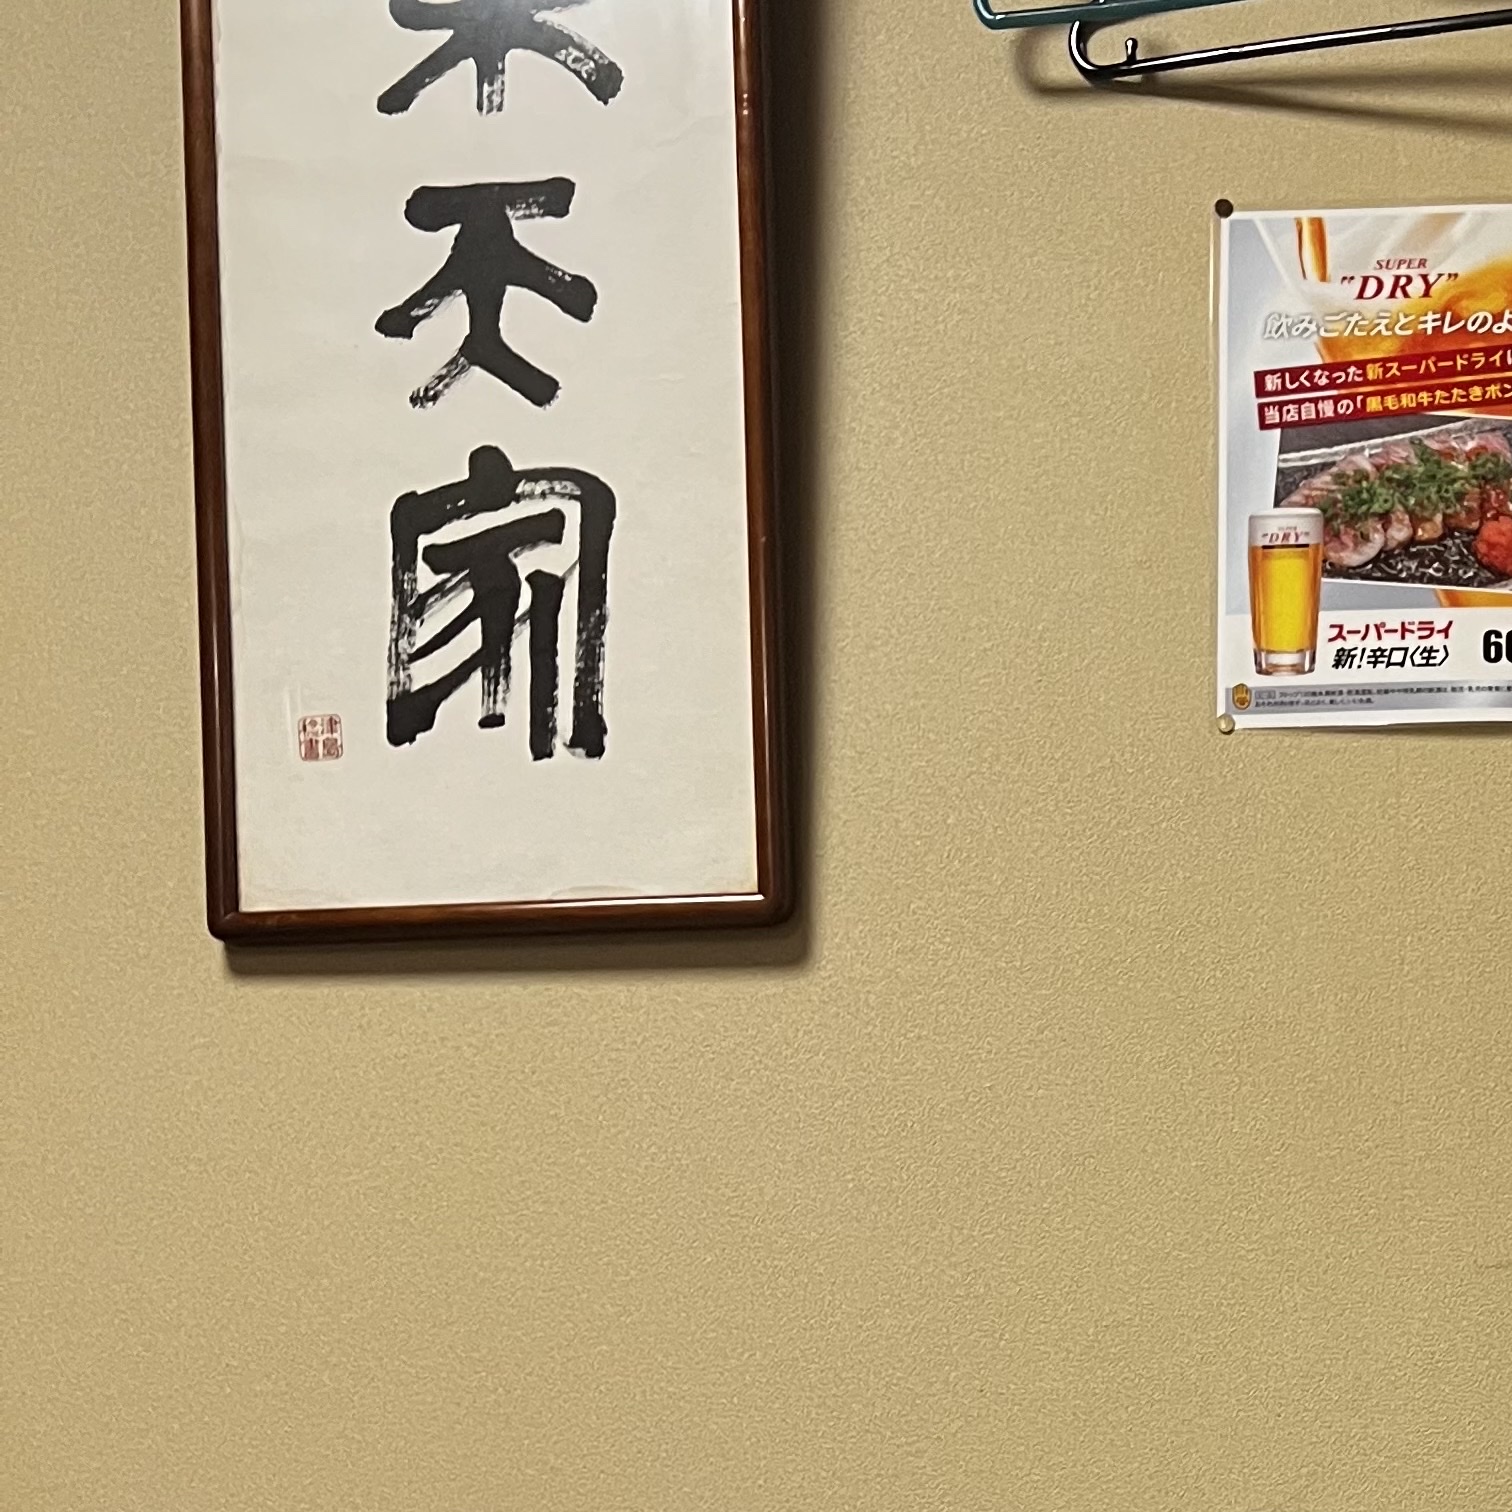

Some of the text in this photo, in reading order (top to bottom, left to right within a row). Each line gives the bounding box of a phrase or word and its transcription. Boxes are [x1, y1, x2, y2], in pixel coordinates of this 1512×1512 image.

[1373, 257, 1428, 271] SUPER
[1327, 620, 1455, 644] スーパードライ
